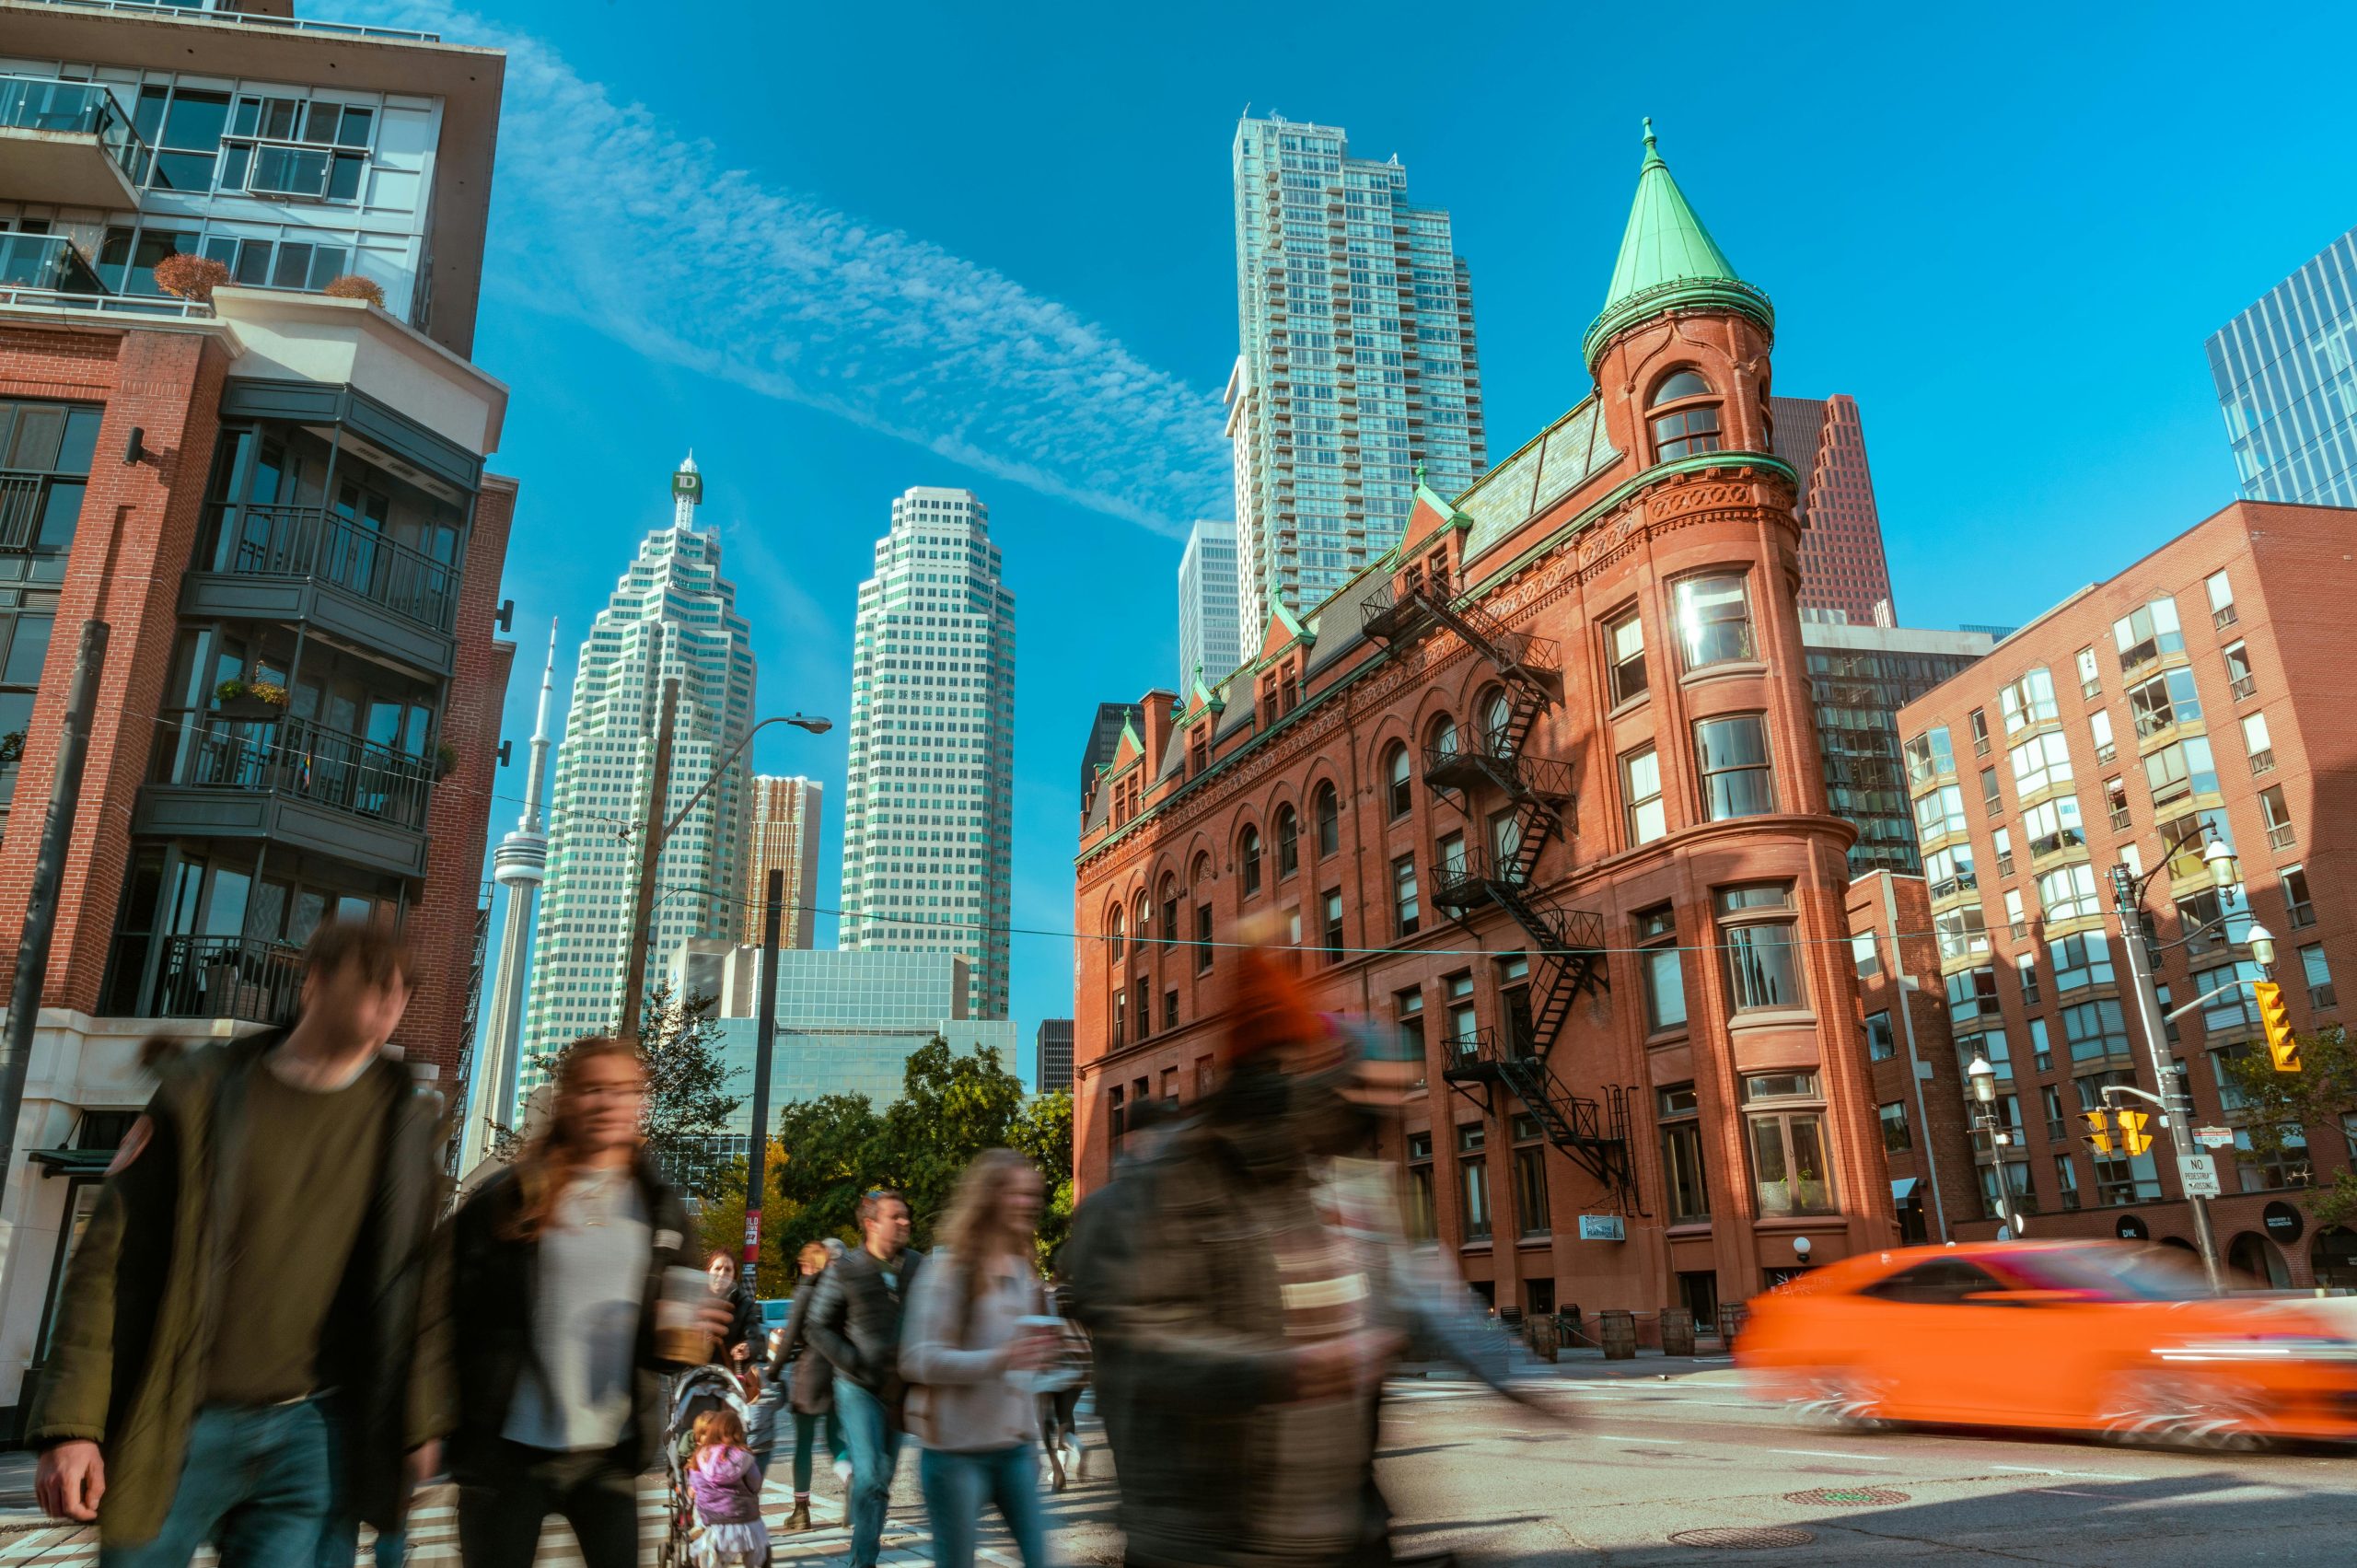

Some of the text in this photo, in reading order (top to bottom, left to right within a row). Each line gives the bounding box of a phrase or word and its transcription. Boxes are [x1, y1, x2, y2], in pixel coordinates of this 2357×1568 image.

[675, 475, 697, 488] TD
[2190, 1159, 2203, 1170] NO
[746, 1217, 759, 1225] OLD
[2121, 1228, 2137, 1237] DW.
